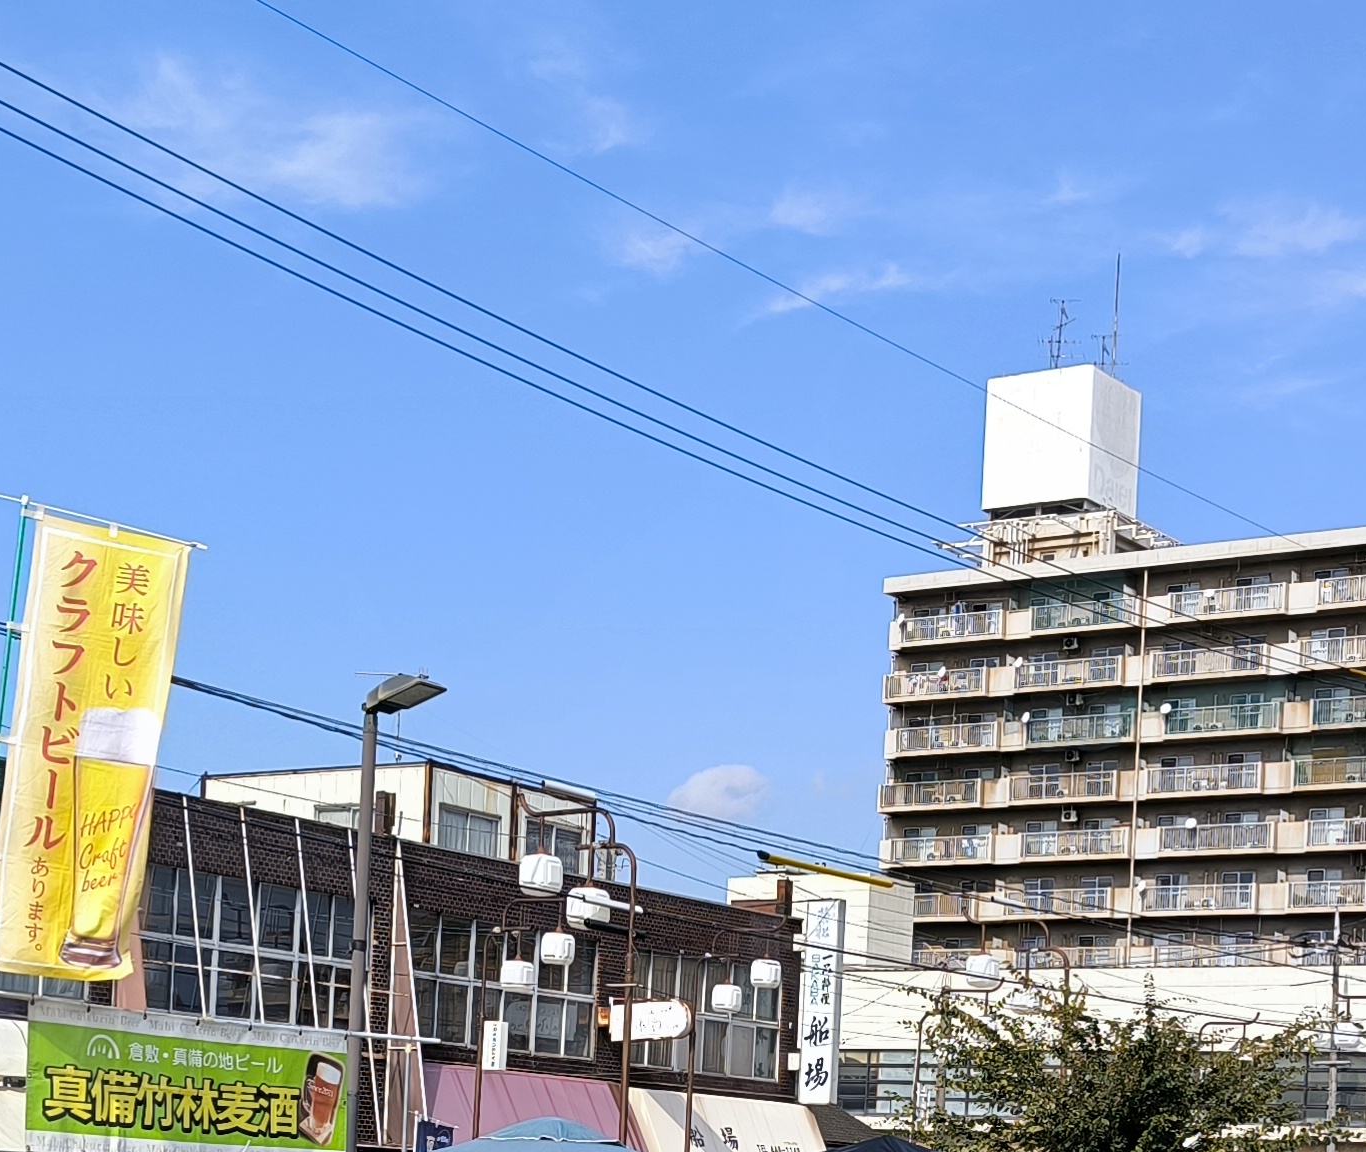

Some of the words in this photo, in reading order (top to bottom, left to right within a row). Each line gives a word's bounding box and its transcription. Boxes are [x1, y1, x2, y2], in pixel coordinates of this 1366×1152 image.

[106, 562, 151, 700] 美味しい
[79, 837, 128, 869] Craft
[81, 870, 119, 893] beer
[127, 1041, 284, 1075] 倉敷・真備の地ビール
[803, 1015, 830, 1092] 船場
[42, 1064, 301, 1138] 真備竹林麦酒
